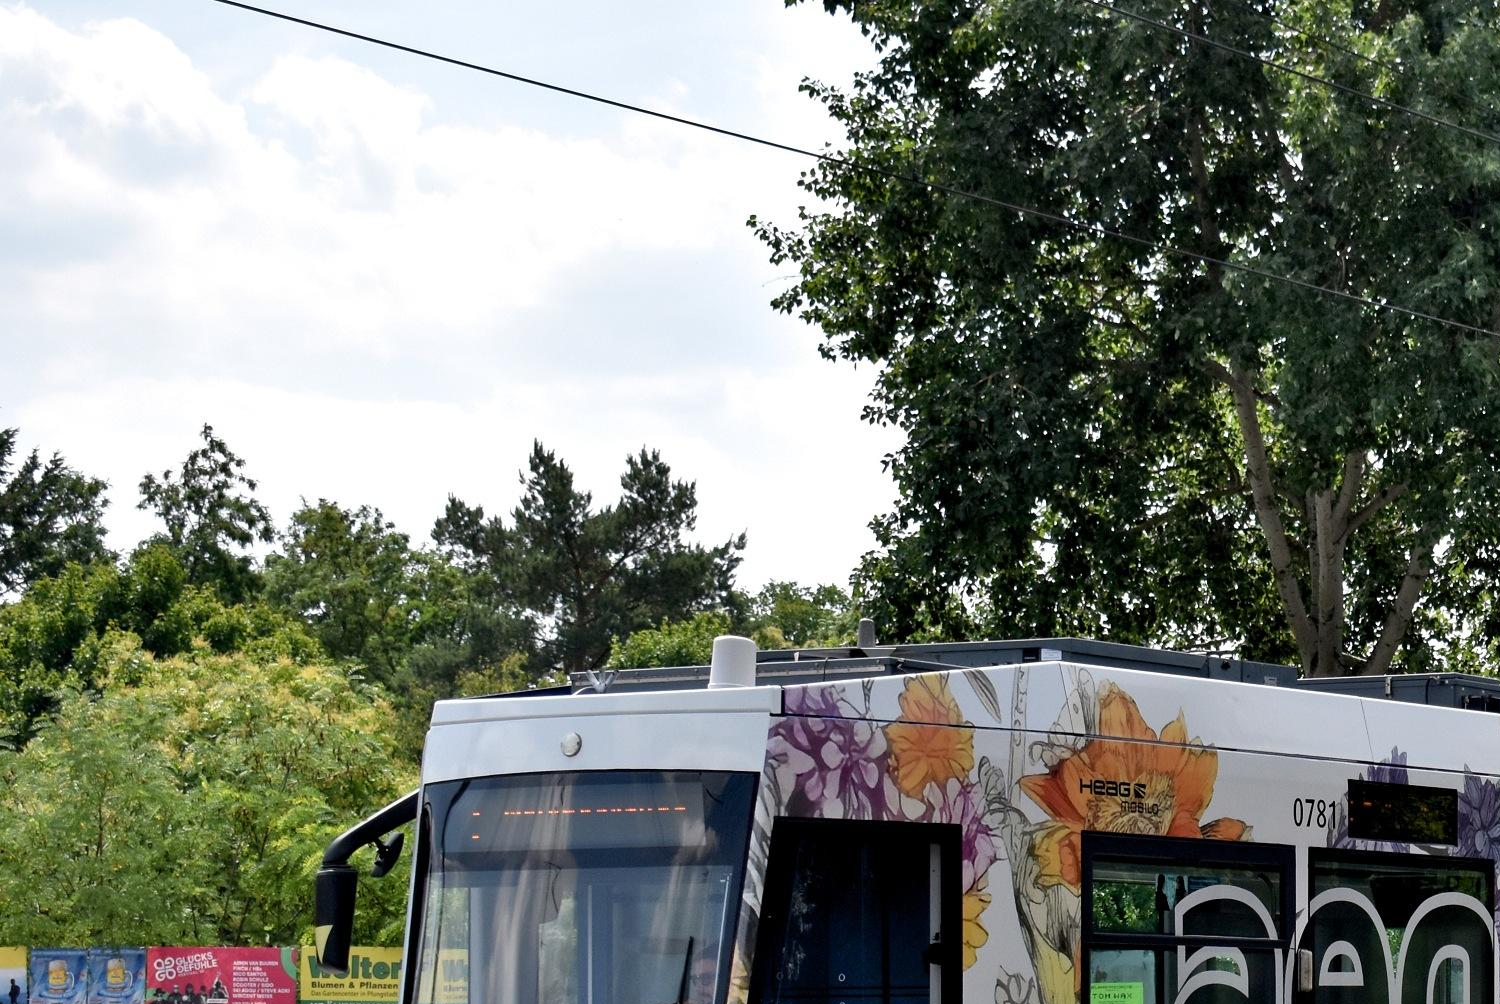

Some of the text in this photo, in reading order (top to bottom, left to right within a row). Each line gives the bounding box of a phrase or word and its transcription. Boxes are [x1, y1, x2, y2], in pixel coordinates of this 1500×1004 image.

[1293, 797, 1337, 829] 0781
[311, 981, 399, 989] Blumen & Pflanzen
